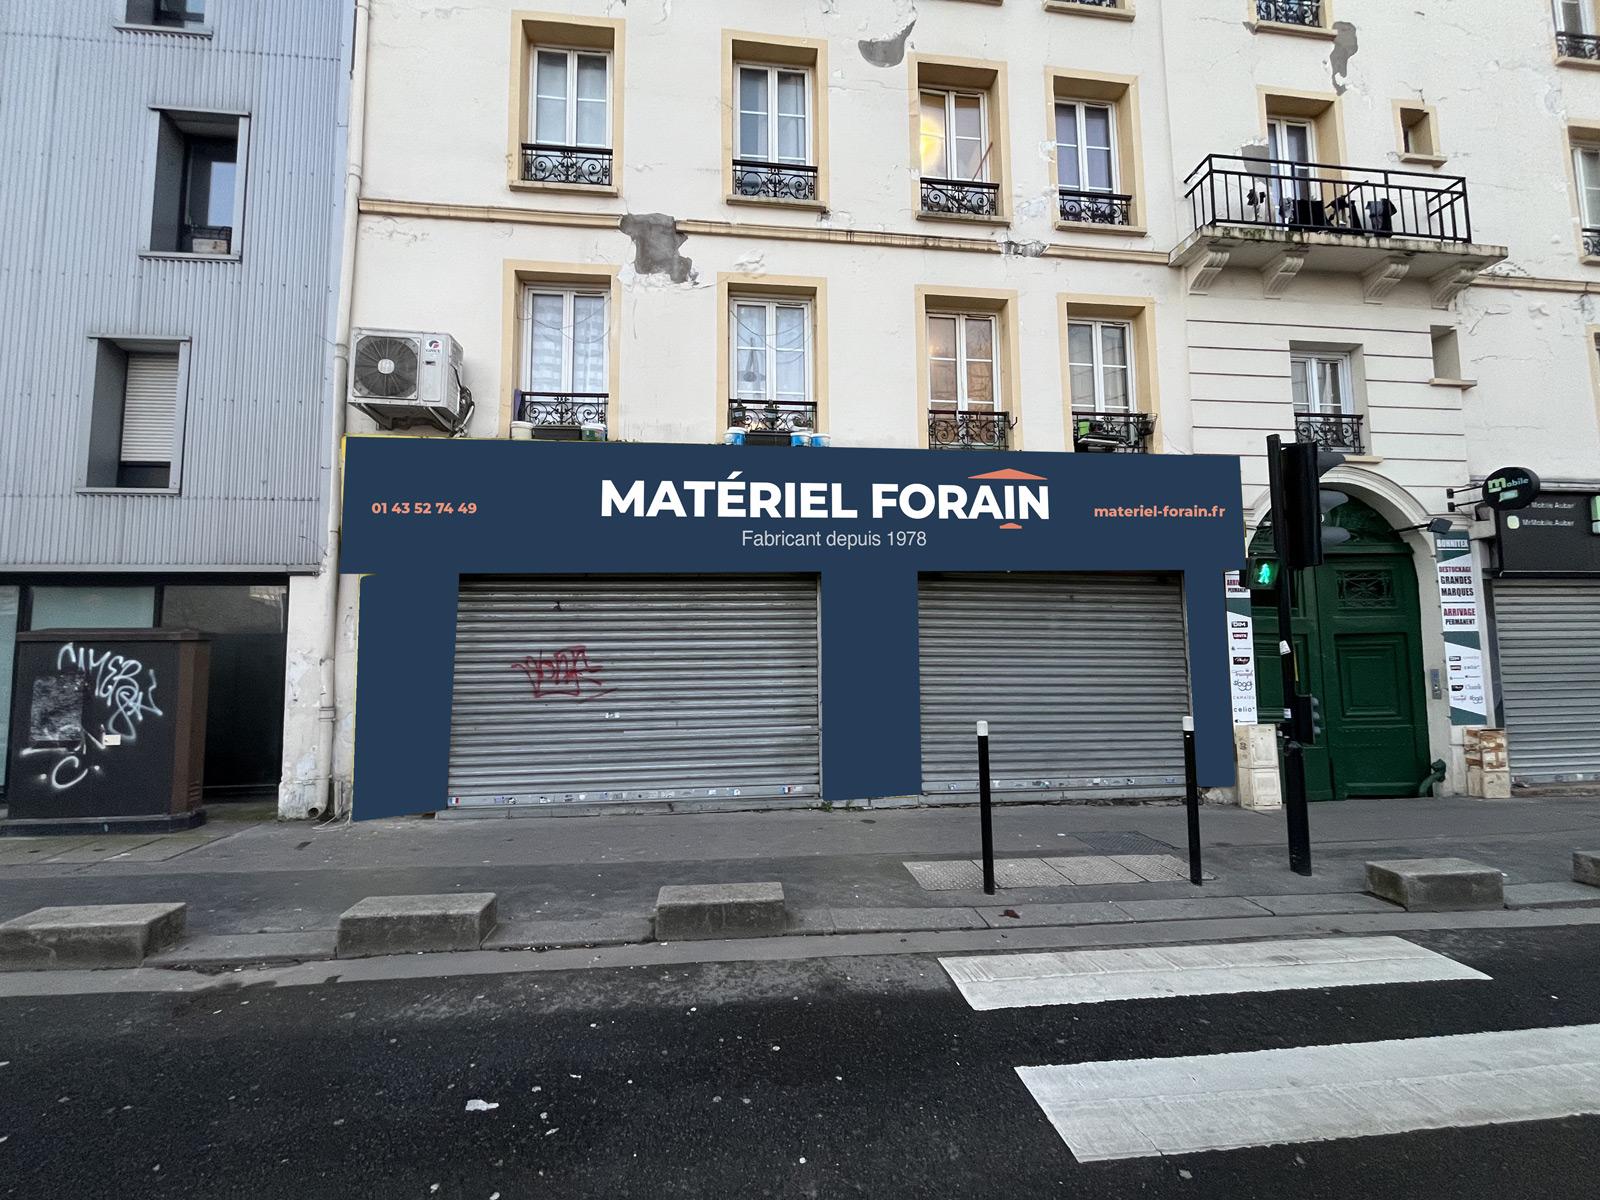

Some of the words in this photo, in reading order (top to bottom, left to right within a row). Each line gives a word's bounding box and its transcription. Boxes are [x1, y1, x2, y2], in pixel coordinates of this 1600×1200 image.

[601, 471, 858, 519] MATÉRIEL
[872, 483, 1050, 520] FORAIN
[371, 501, 388, 514] 01
[391, 501, 411, 515] 43
[413, 501, 432, 515] 52
[435, 501, 455, 514] 74
[457, 501, 478, 514] 49
[1093, 505, 1227, 518] materiel-forain.fr
[742, 530, 822, 547] Fabricant
[825, 530, 881, 551] depuis
[887, 531, 927, 547] 1978
[1441, 576, 1472, 584] GRANDES
[1441, 588, 1474, 597] MARQUES
[1443, 608, 1476, 616] ARRIVAGE
